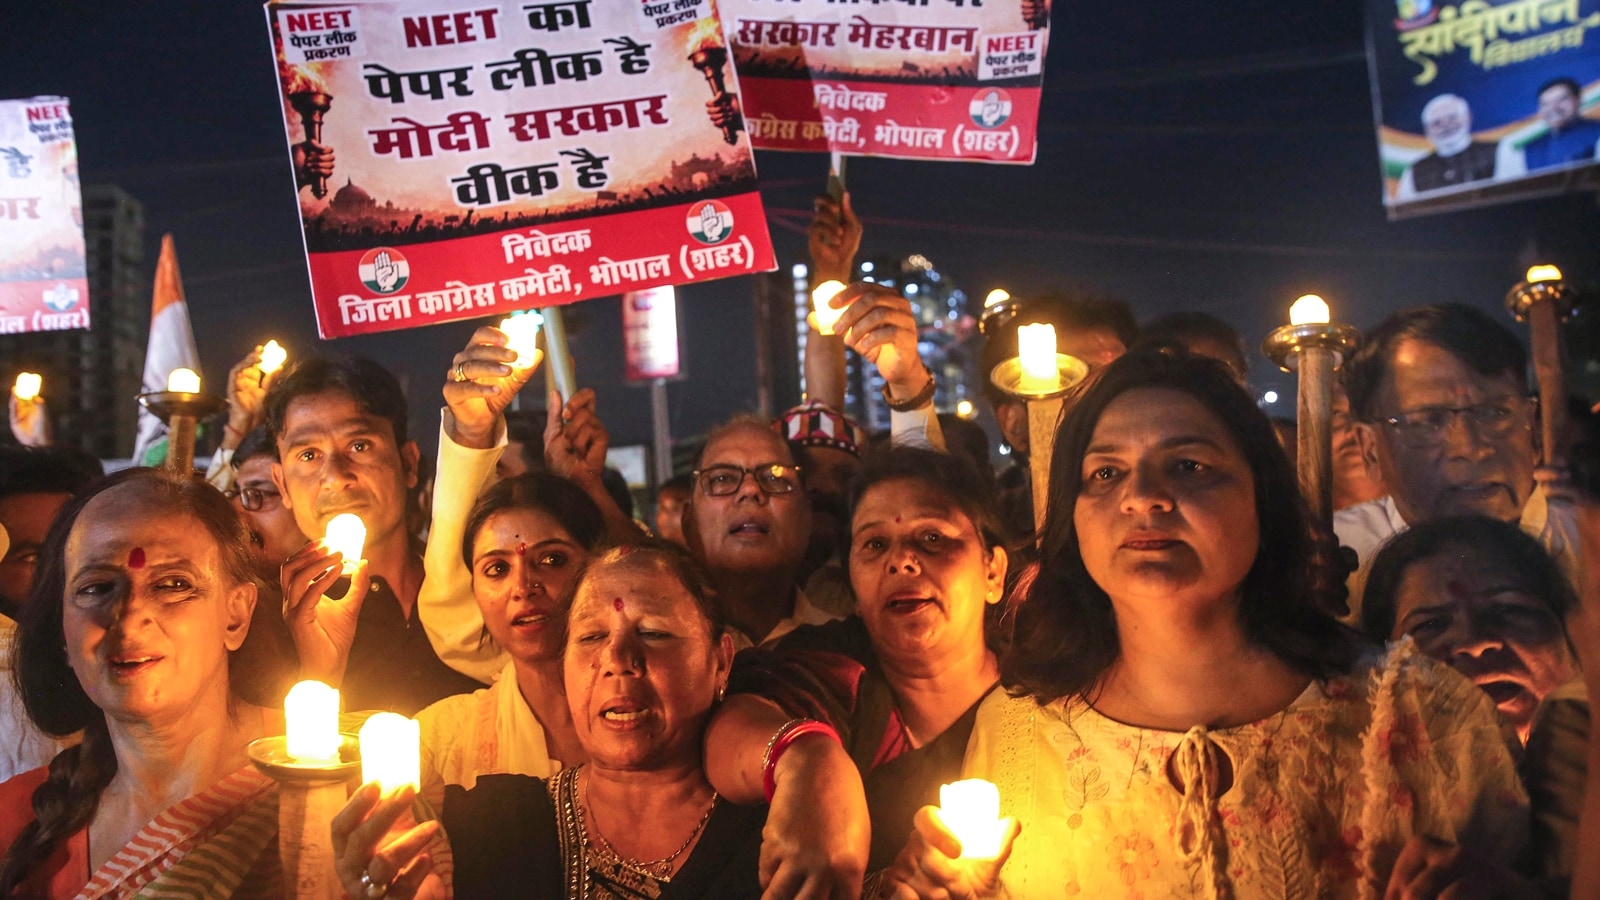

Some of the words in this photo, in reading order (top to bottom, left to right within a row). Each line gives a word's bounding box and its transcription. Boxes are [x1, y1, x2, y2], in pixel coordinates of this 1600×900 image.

[286, 10, 352, 33] NEET
[402, 8, 498, 48] NEET
[523, 0, 592, 32] का
[643, 3, 671, 17] पेपर
[655, 9, 698, 28] प्रकरण
[289, 33, 321, 48] पेपर
[323, 30, 357, 45] लीक
[738, 18, 841, 47] सरकार
[848, 15, 978, 52] मेहरबान
[987, 34, 1038, 53] NEET
[303, 45, 351, 61] प्रकरण
[363, 63, 474, 104] पेपर
[485, 48, 603, 91] लीक
[603, 36, 652, 75] है
[813, 84, 888, 112] निवेदक
[368, 111, 492, 160] मोदी
[504, 94, 669, 142] सरकार
[802, 115, 867, 148] कमेटी,
[874, 119, 947, 149] भोपाल
[952, 123, 1020, 158] (शहर)
[451, 163, 559, 205] वीक
[559, 148, 609, 189] है
[501, 229, 592, 264] निवेदक
[337, 294, 412, 325] जिला
[499, 264, 583, 302] कमेटी,
[589, 254, 671, 286] भोपाल
[680, 234, 755, 279] (शहर)
